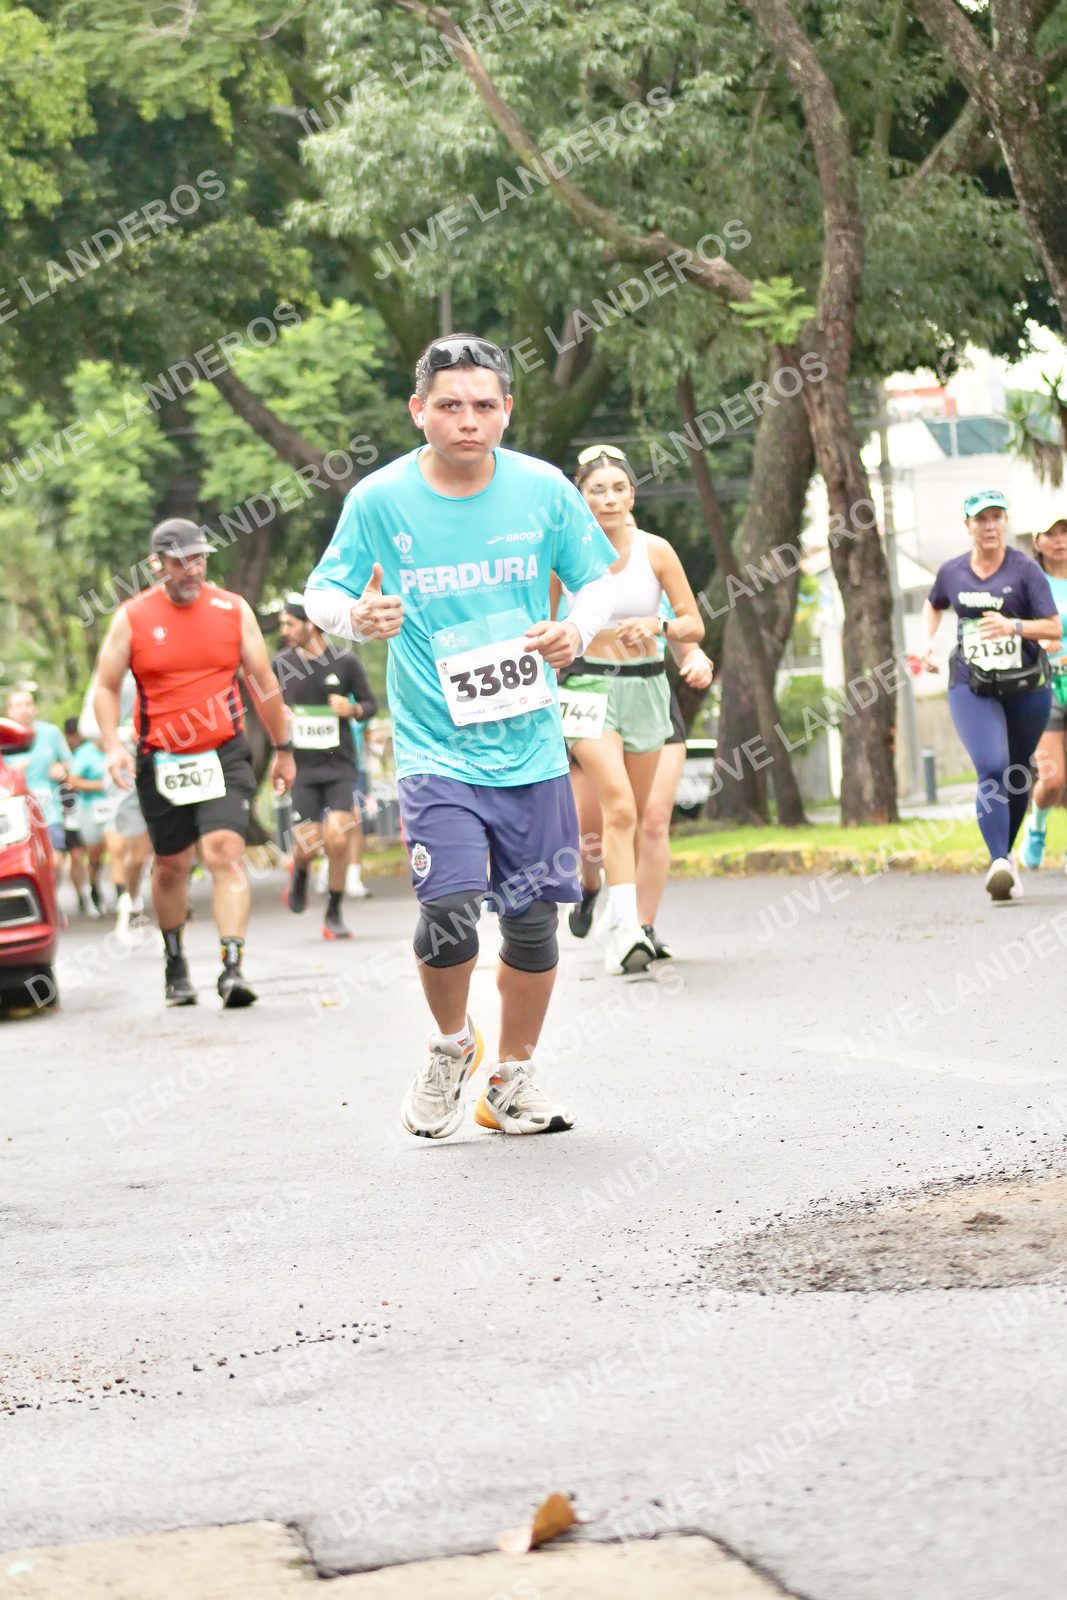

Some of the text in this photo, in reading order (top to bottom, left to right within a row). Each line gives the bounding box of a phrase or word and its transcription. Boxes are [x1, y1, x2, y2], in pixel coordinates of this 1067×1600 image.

[399, 554, 538, 594] PERDURA
[968, 641, 1016, 662] 2130
[450, 654, 538, 703] 3389
[165, 768, 215, 790] 6207
